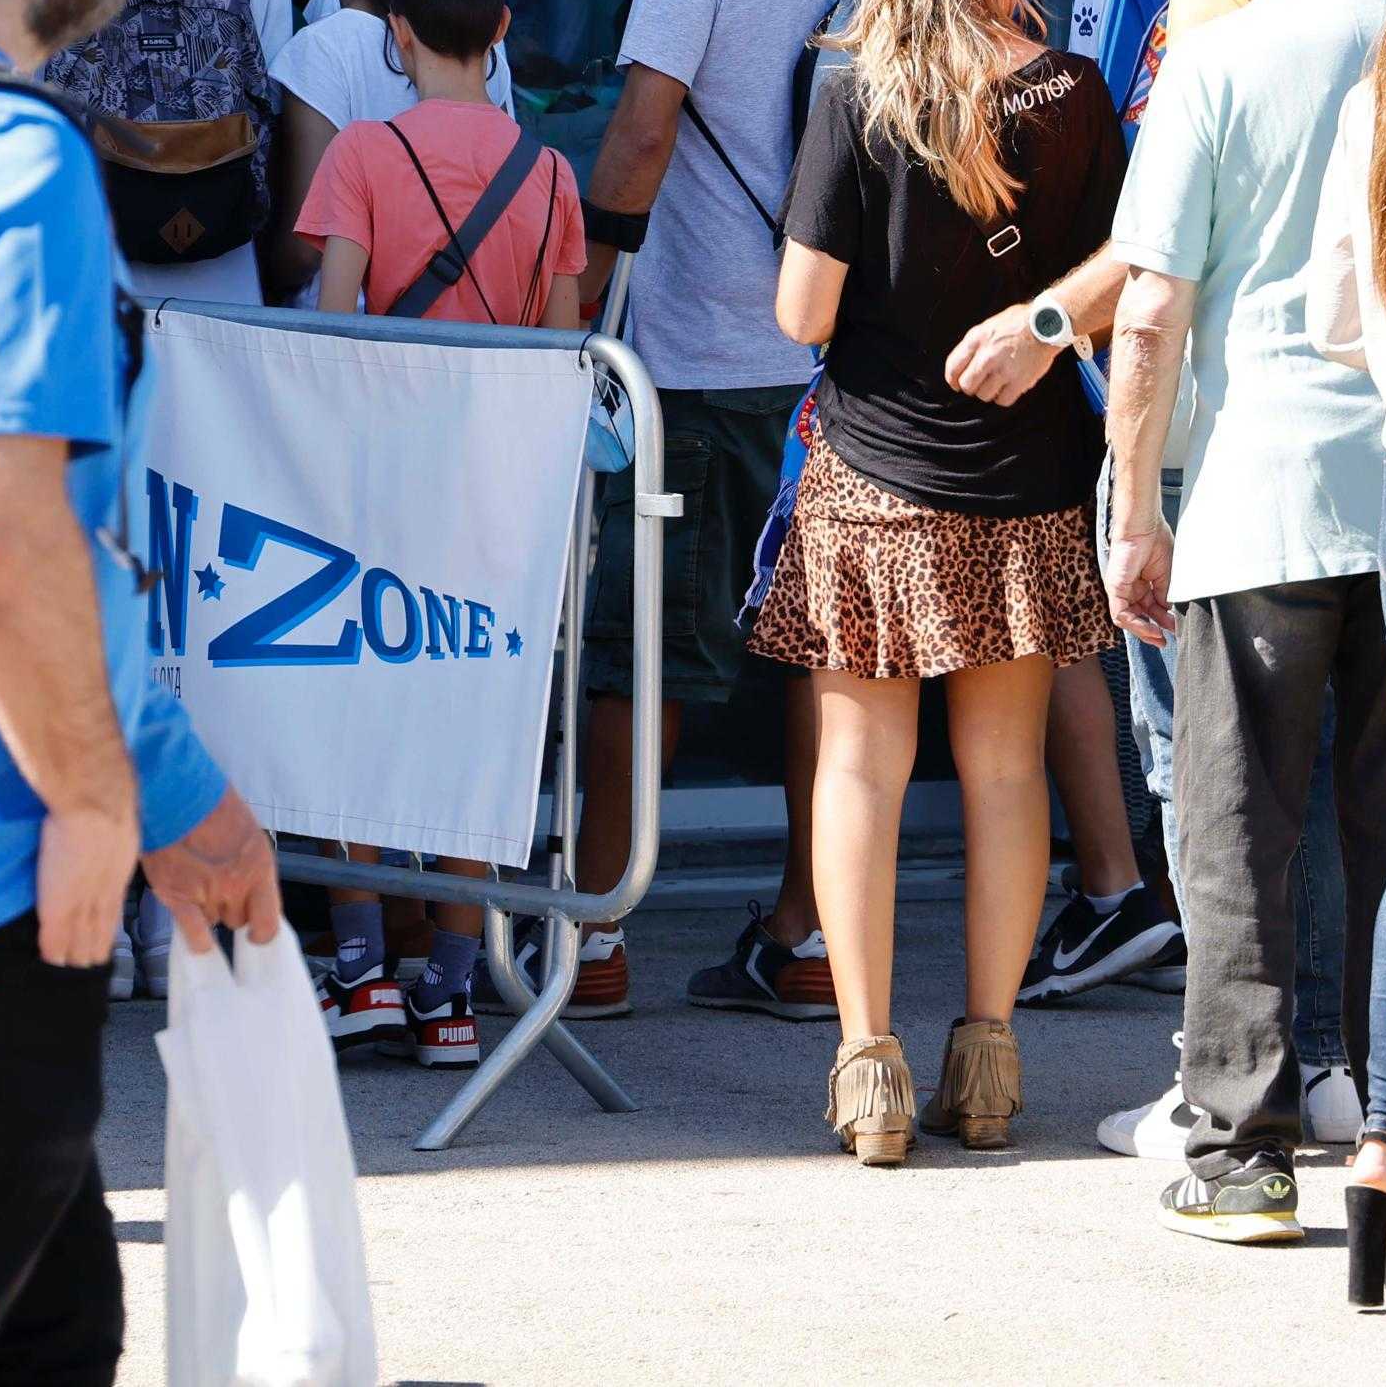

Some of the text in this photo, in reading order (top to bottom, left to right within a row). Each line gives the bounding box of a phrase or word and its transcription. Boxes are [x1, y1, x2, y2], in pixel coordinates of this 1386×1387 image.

[1002, 69, 1076, 117] MOTION
[208, 501, 496, 669] ZONE
[438, 1025, 476, 1043] PUMA
